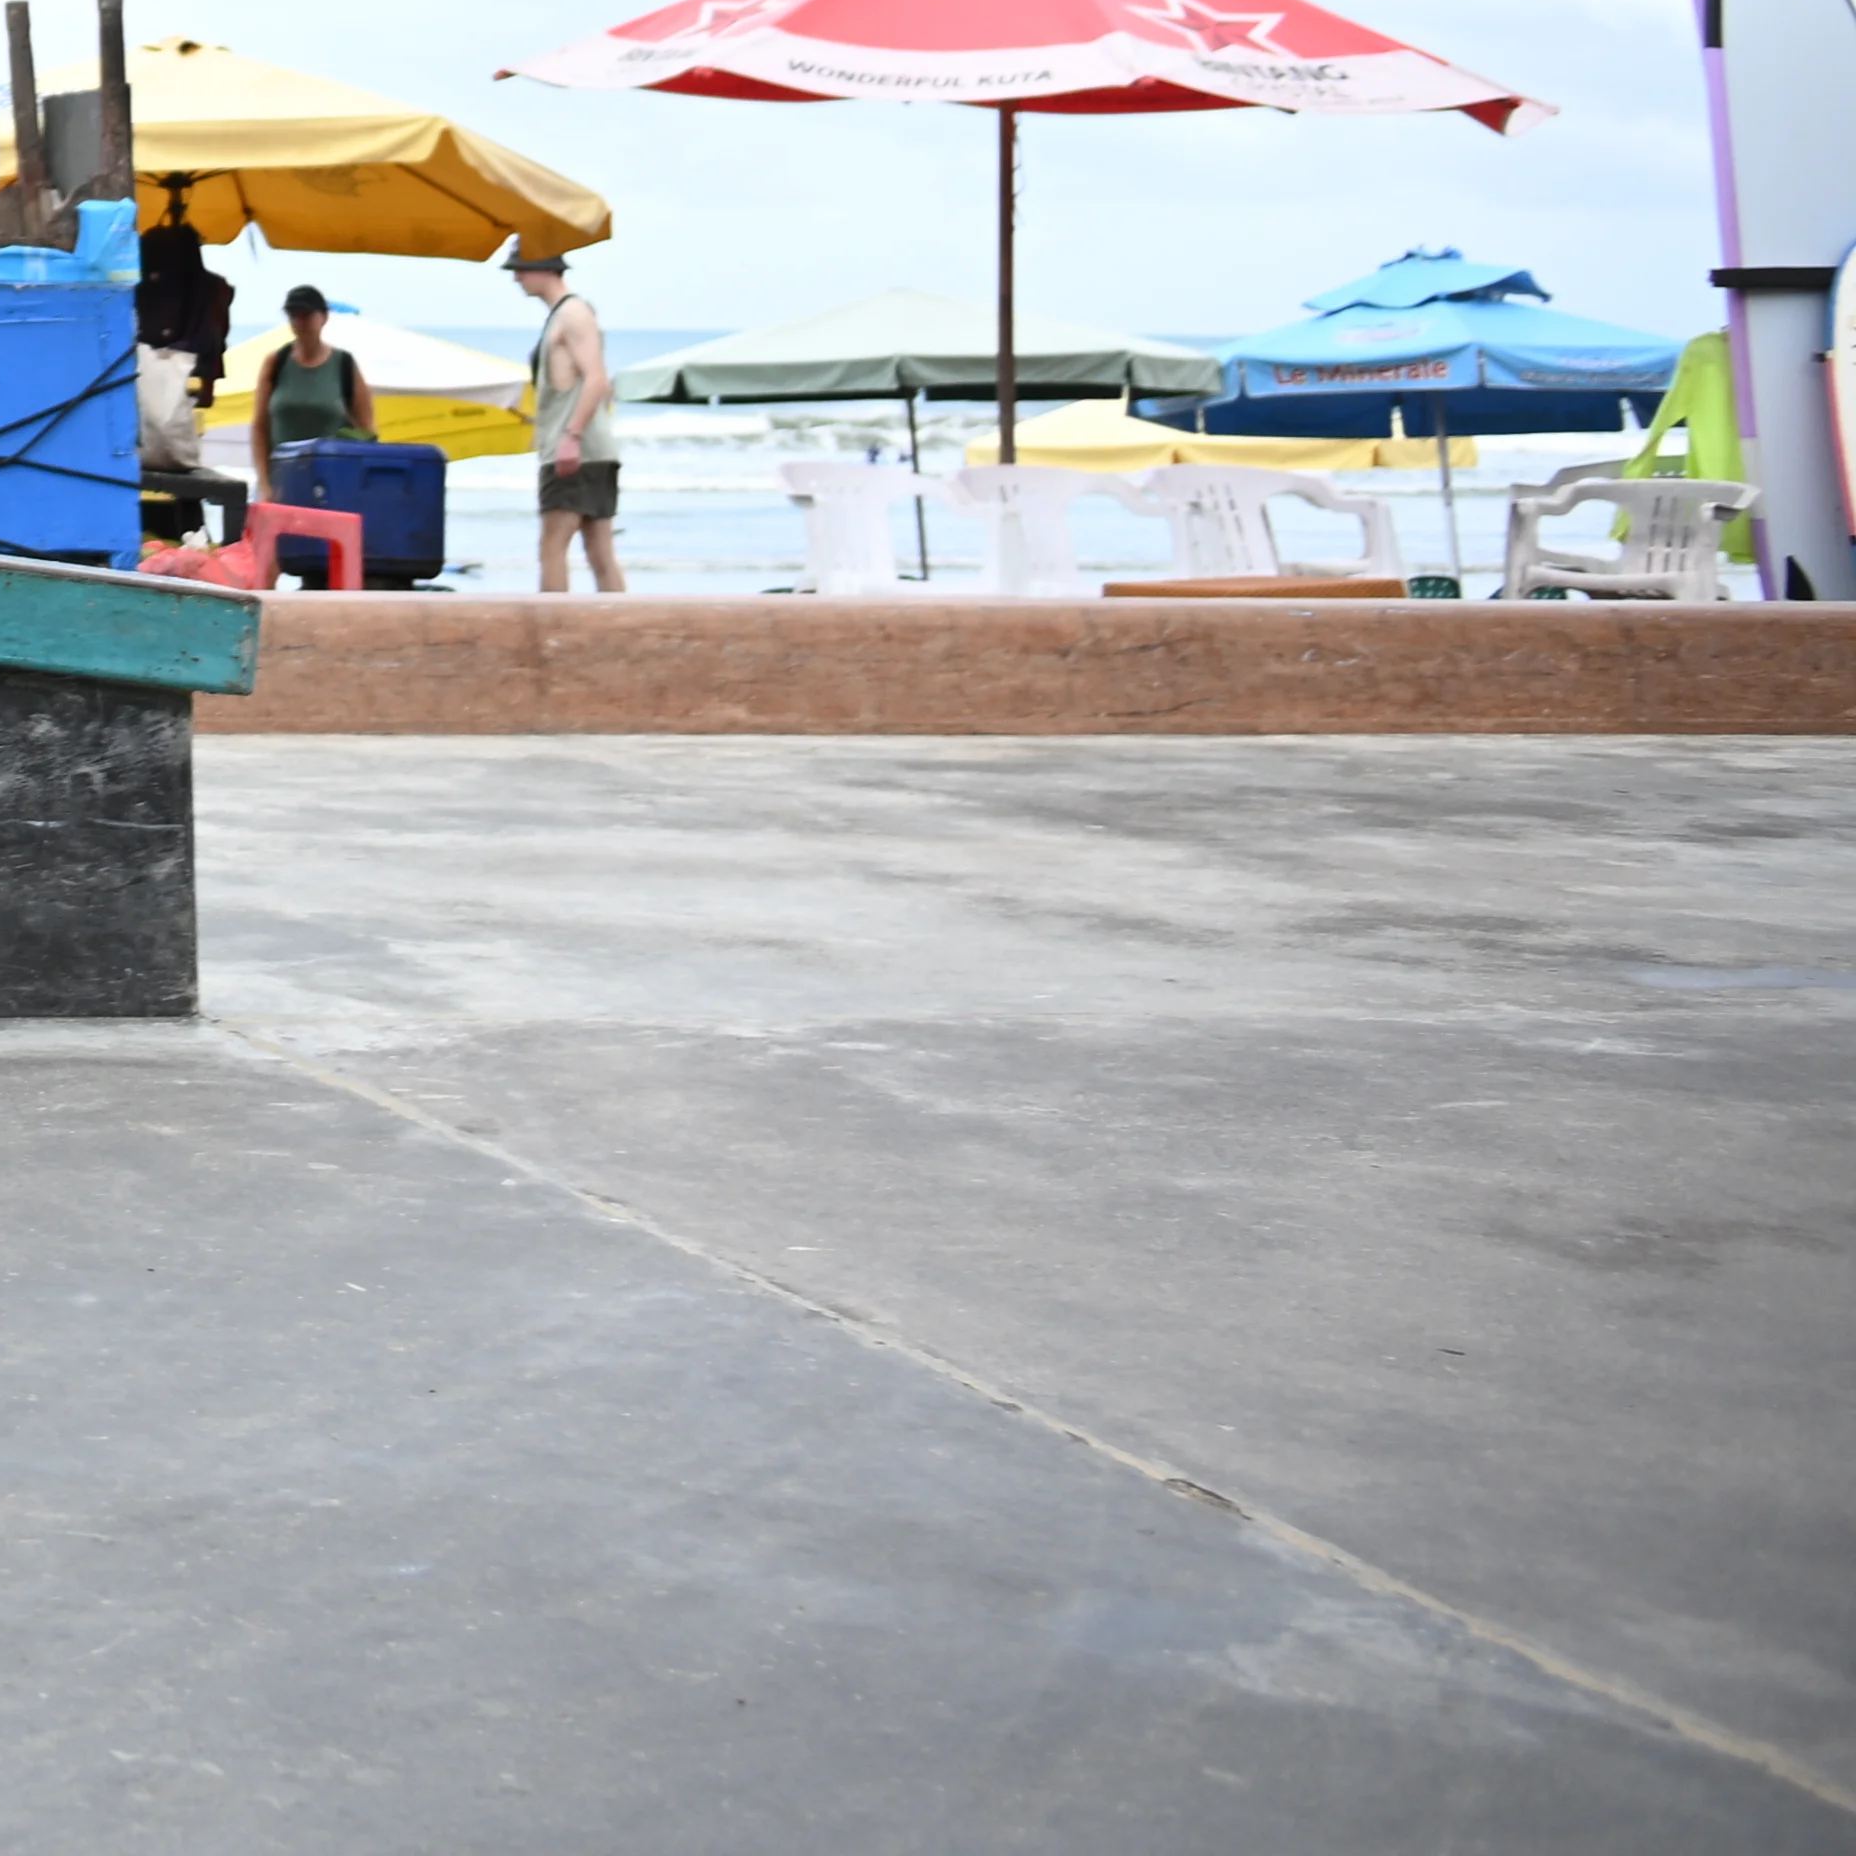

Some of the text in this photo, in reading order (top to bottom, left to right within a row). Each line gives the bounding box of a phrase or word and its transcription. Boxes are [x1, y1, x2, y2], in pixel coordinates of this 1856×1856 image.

[787, 59, 1053, 88] WONDERFUL KUTA
[1273, 357, 1448, 385] Le Minerale
